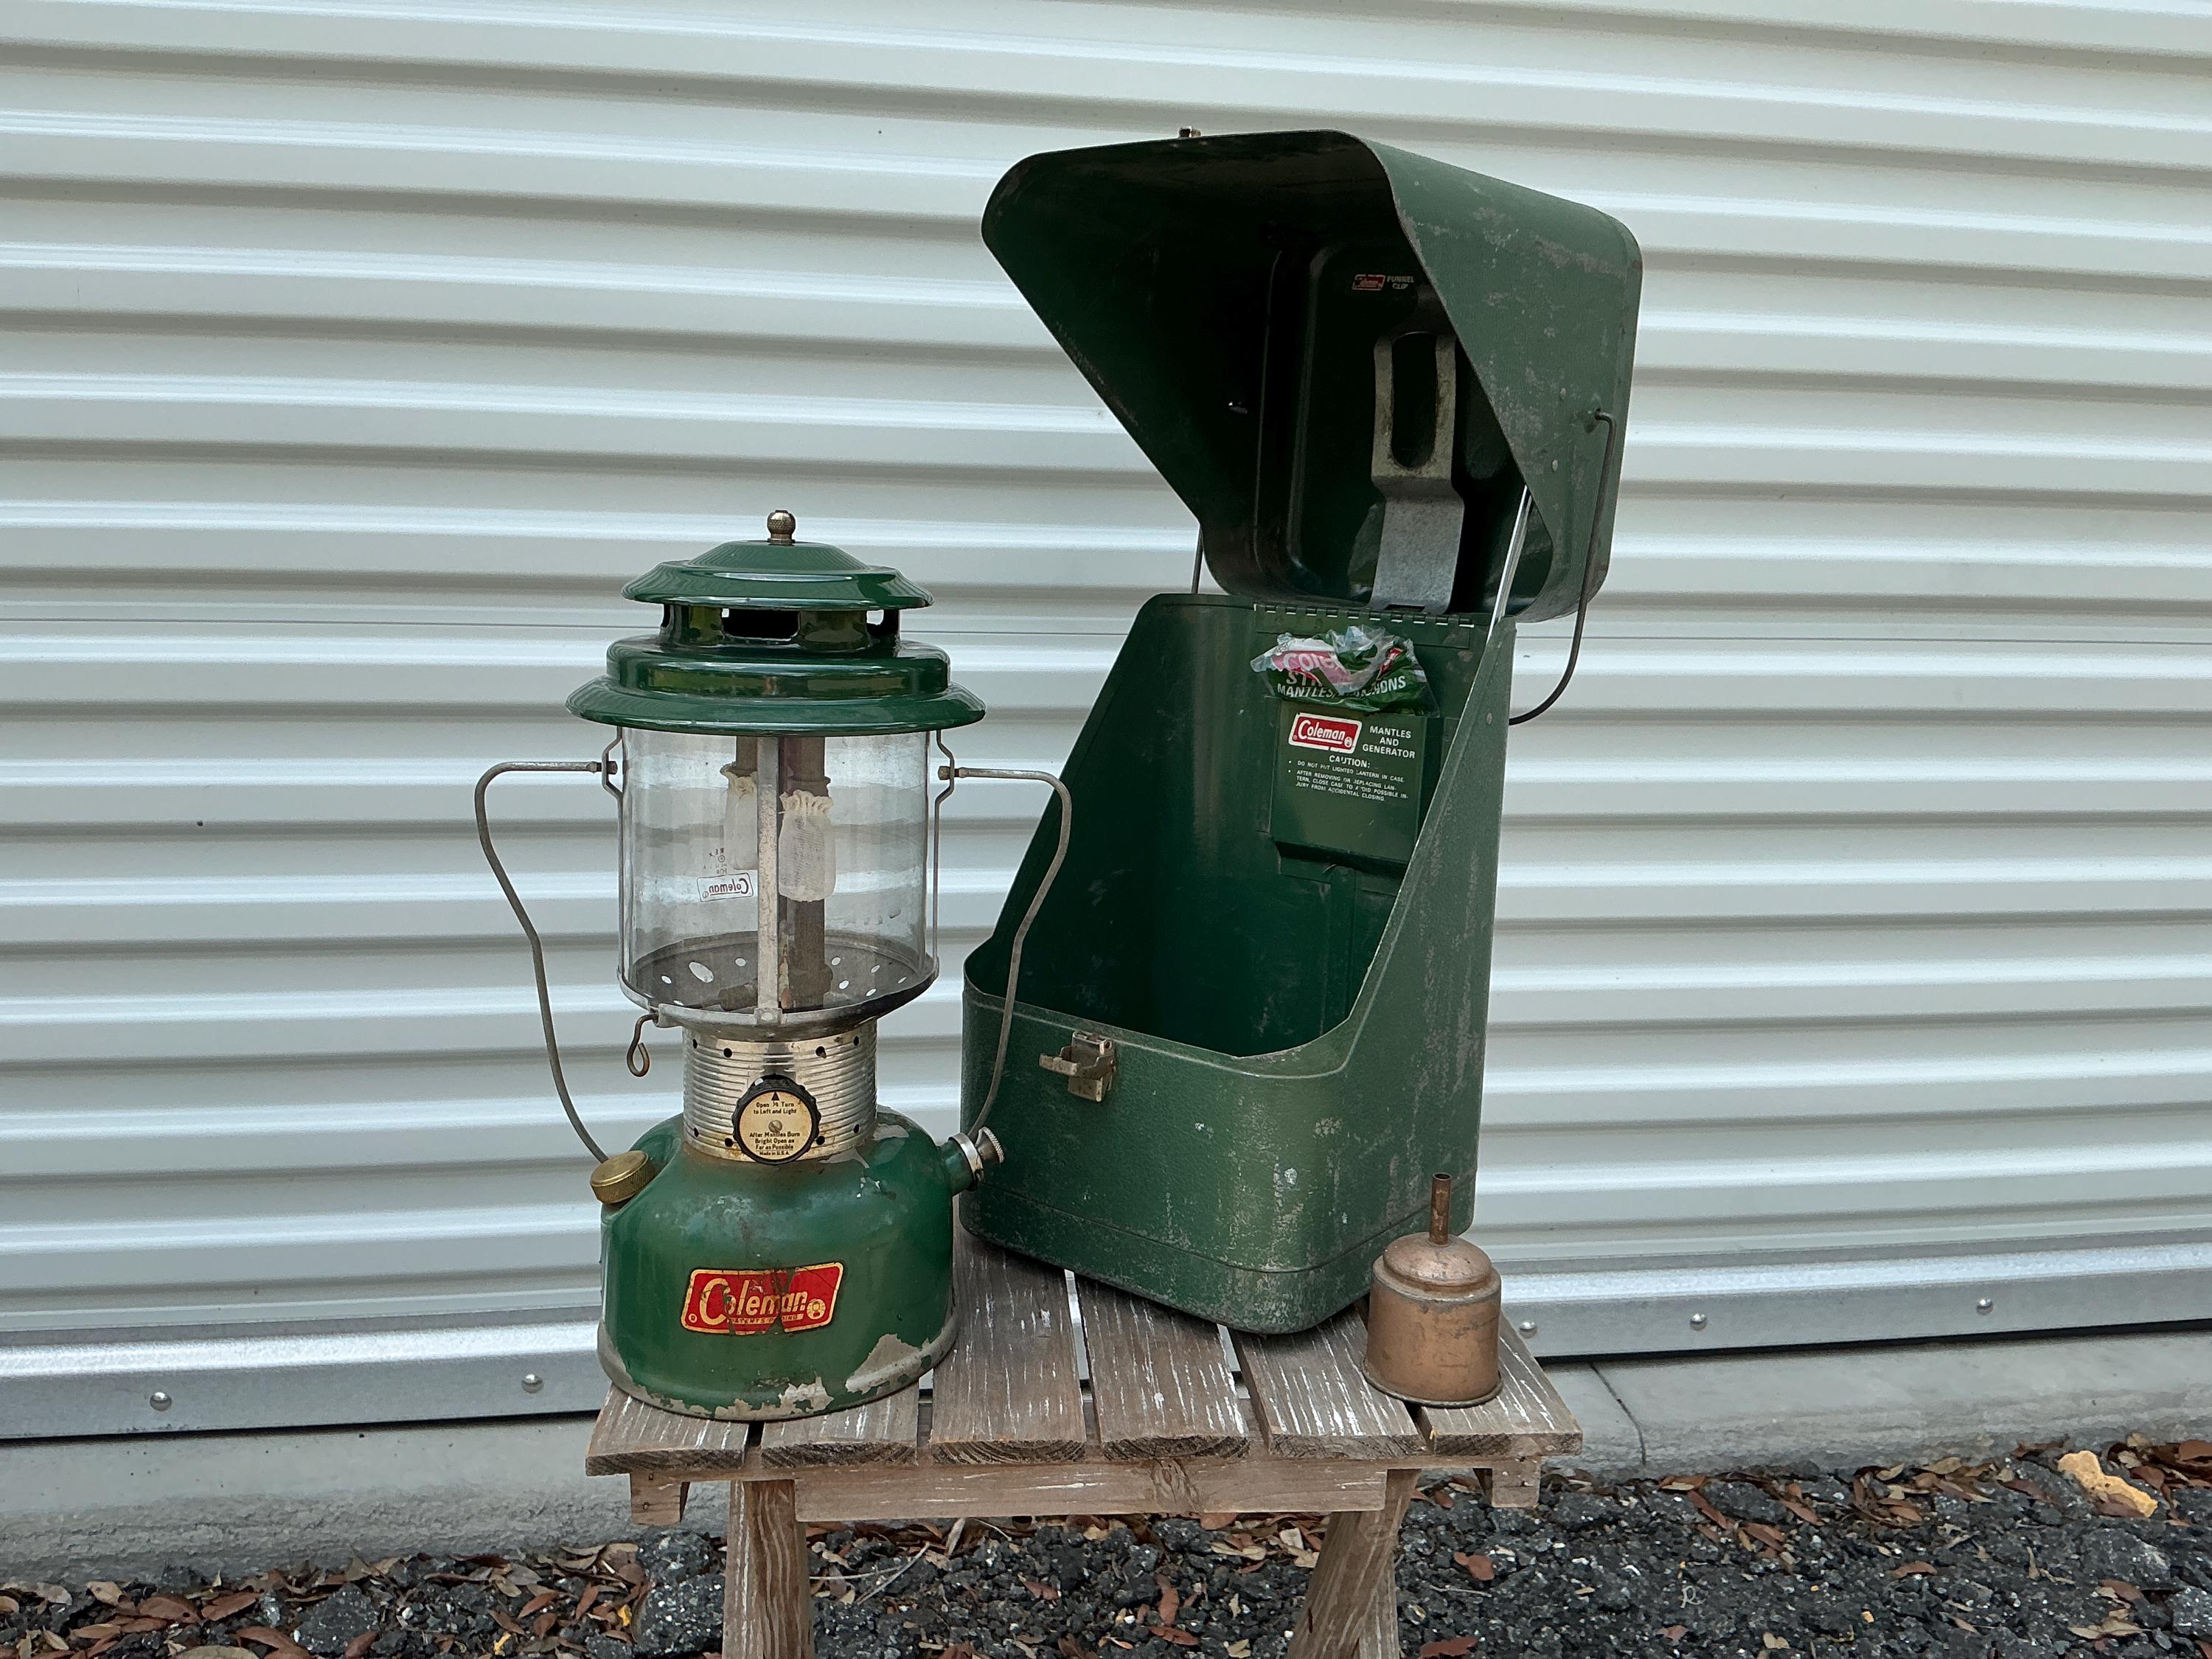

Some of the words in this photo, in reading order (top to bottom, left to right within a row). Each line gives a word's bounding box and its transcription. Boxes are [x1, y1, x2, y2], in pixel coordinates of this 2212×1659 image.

[1387, 275, 1414, 283] FUNNEL
[1298, 720, 1346, 740] Coleman
[1369, 726, 1411, 739] MANTLES
[1380, 737, 1399, 746] AND
[1363, 743, 1415, 758] GENERATOR
[1329, 755, 1371, 768] CAUTION:
[1332, 766, 1354, 774] LIGHTED
[1314, 773, 1340, 782] REMOVING
[1374, 789, 1398, 798] POSSIBLE
[700, 1278, 808, 1325] Coleman
